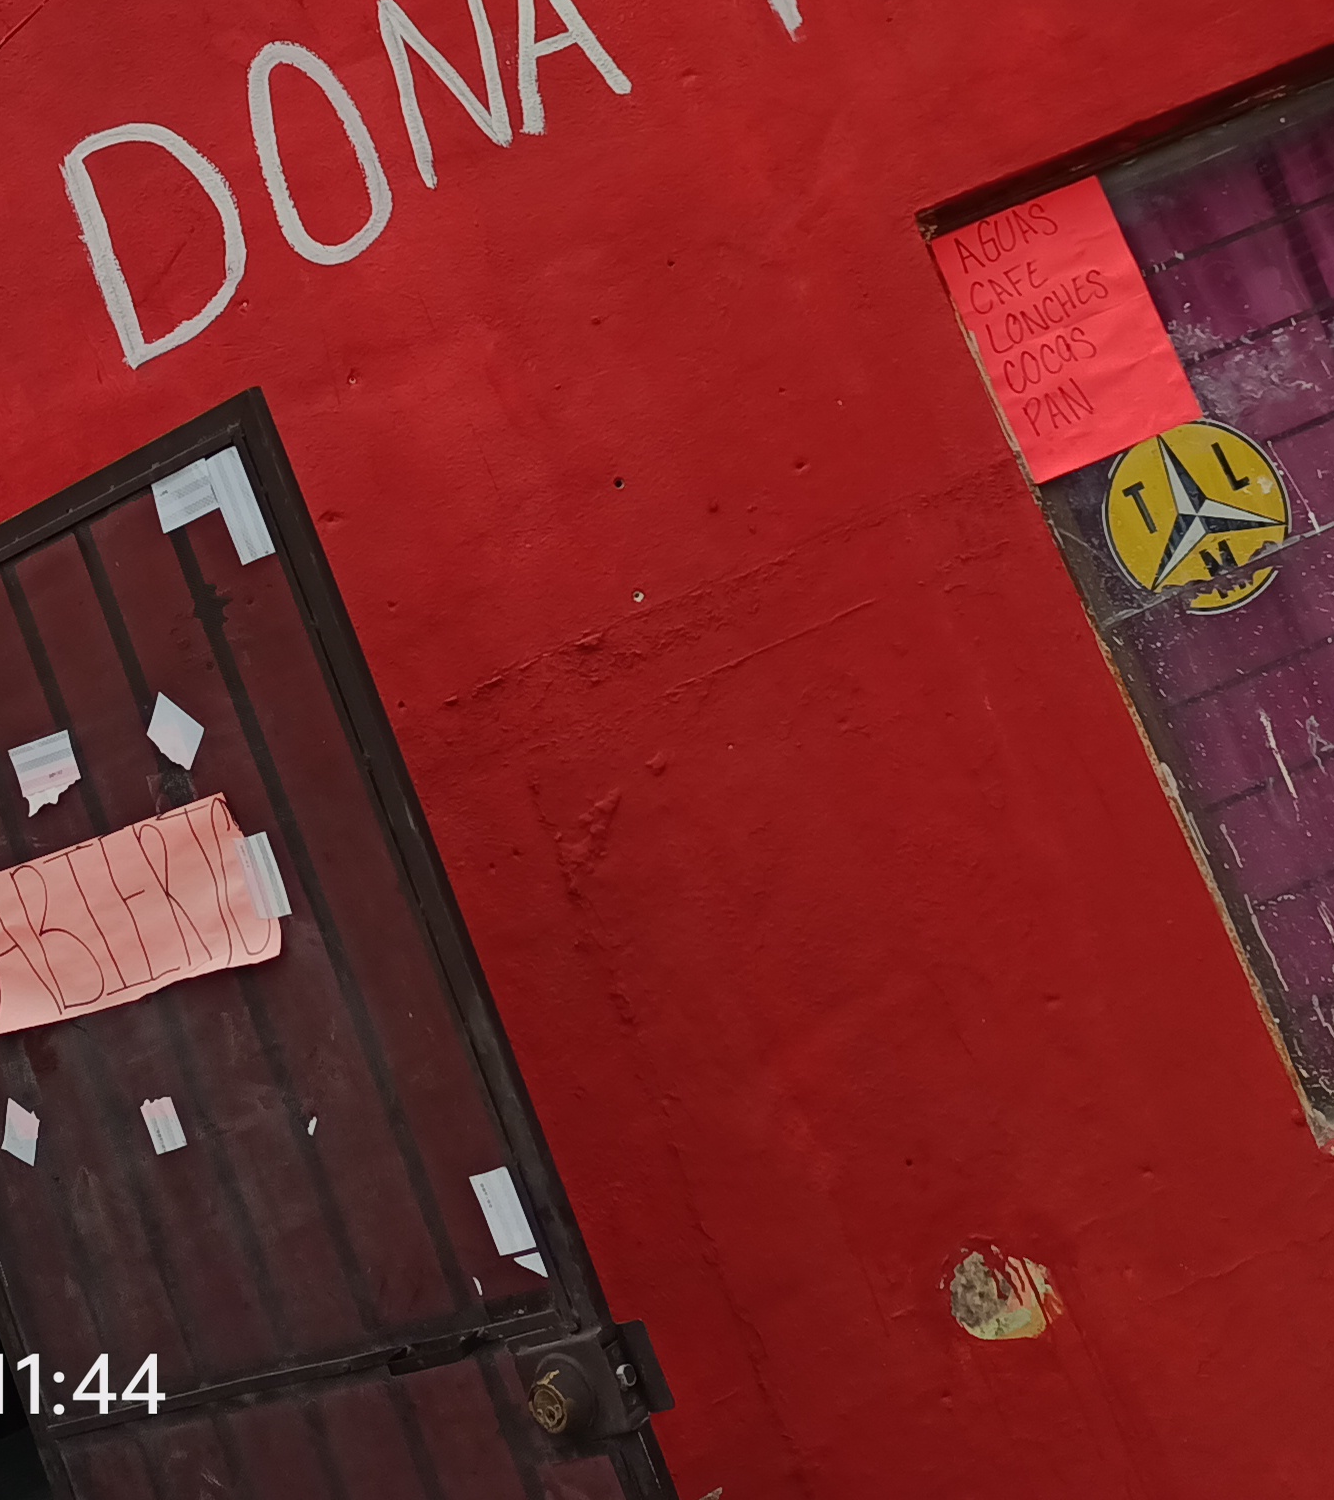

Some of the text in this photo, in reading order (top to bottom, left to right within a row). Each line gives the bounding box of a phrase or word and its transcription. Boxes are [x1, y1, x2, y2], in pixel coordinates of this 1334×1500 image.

[953, 203, 1058, 274] AGUAS
[969, 259, 1049, 315] CAFE
[985, 269, 1109, 354] LONCHES
[1022, 378, 1094, 437] PAN
[1122, 481, 1158, 534] T
[1211, 442, 1250, 491] L
